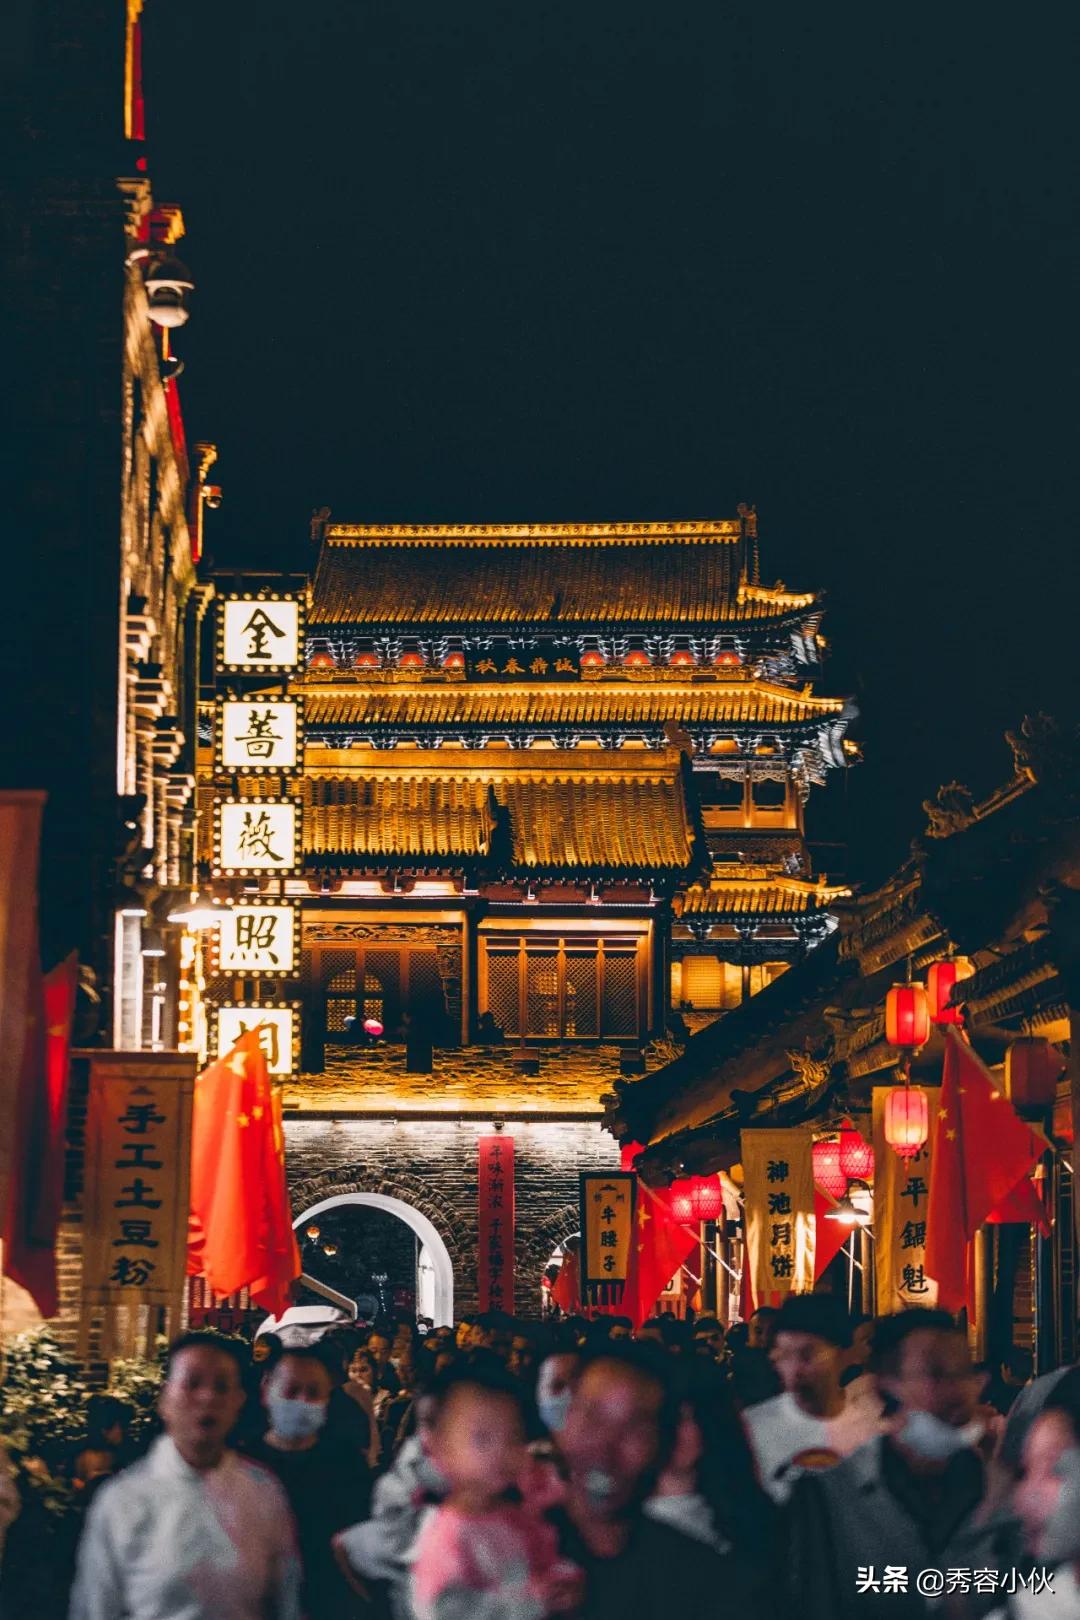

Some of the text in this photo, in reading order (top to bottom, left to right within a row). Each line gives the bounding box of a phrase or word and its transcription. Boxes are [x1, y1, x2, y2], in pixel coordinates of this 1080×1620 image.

[110, 1103, 166, 1286] 手工土豆粉
[600, 1205, 617, 1272] 牛腰子
[767, 1160, 794, 1278] 神池月饼
[899, 1141, 929, 1294] 平鍋魁
